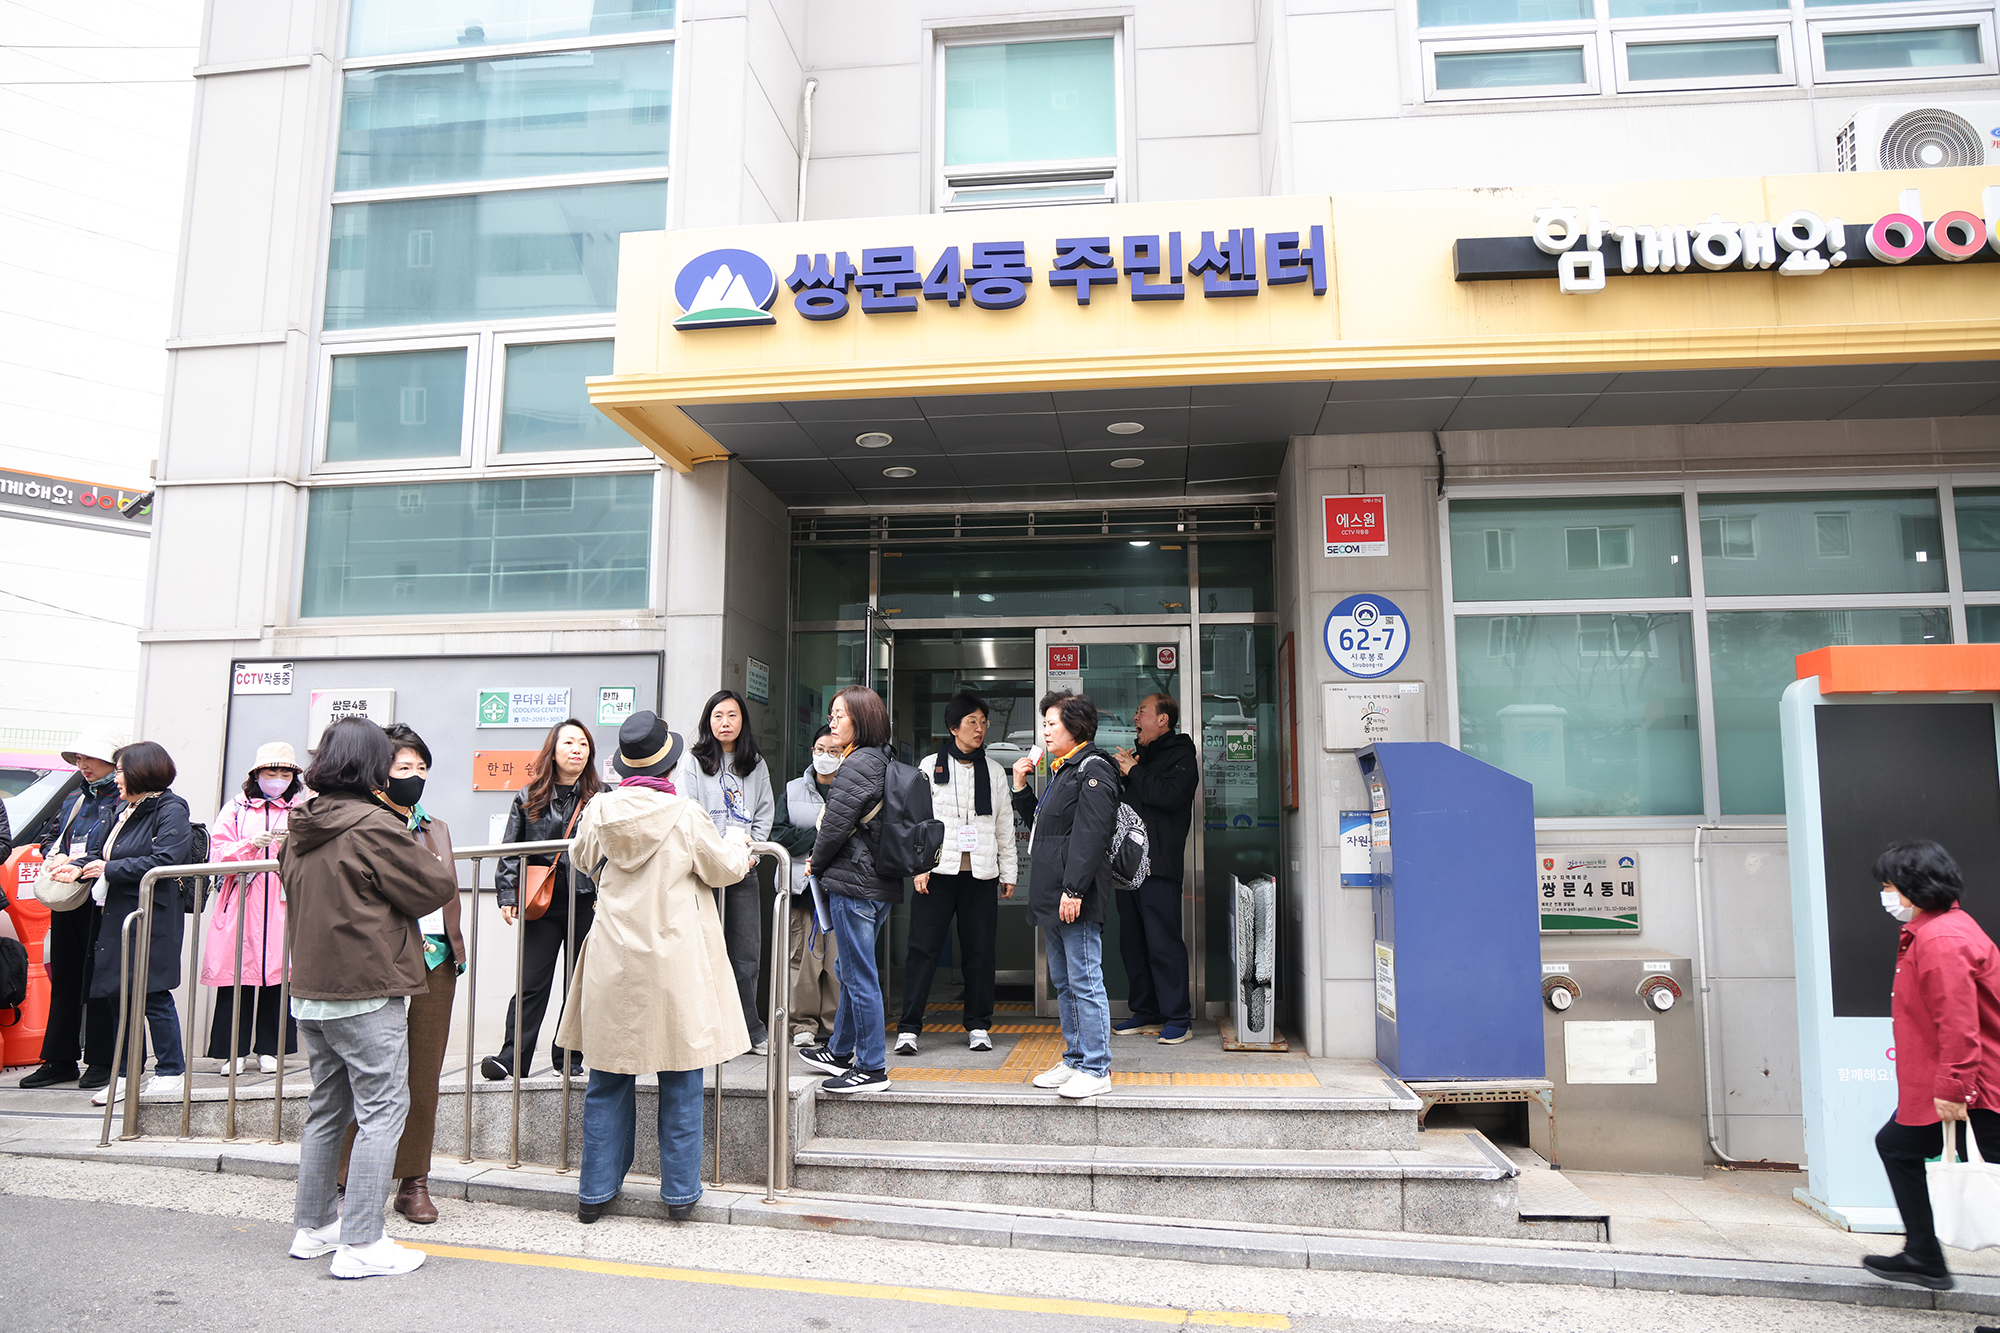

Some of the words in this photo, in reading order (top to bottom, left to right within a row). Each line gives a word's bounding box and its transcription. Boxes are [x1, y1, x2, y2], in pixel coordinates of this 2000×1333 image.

[1532, 198, 1846, 295] 함께해요!
[784, 240, 1033, 321] 쌍문4동
[1048, 225, 1327, 306] 주민센터
[1336, 512, 1375, 528] 에스원
[1327, 545, 1360, 554] SECOM
[1339, 628, 1395, 651] 62-7
[1351, 653, 1384, 662] 시루봉로
[236, 672, 291, 686] CCTV작동중
[512, 693, 544, 706] 무더위
[546, 692, 568, 705] 쉼터
[602, 691, 619, 701] 한파
[332, 700, 368, 711] 쌍문4동
[512, 706, 540, 714] (COOLING
[616, 702, 631, 711] 쉼터
[487, 762, 514, 777] 한파
[1346, 835, 1371, 847] 자원
[1837, 1067, 1894, 1082] 함께해요!
